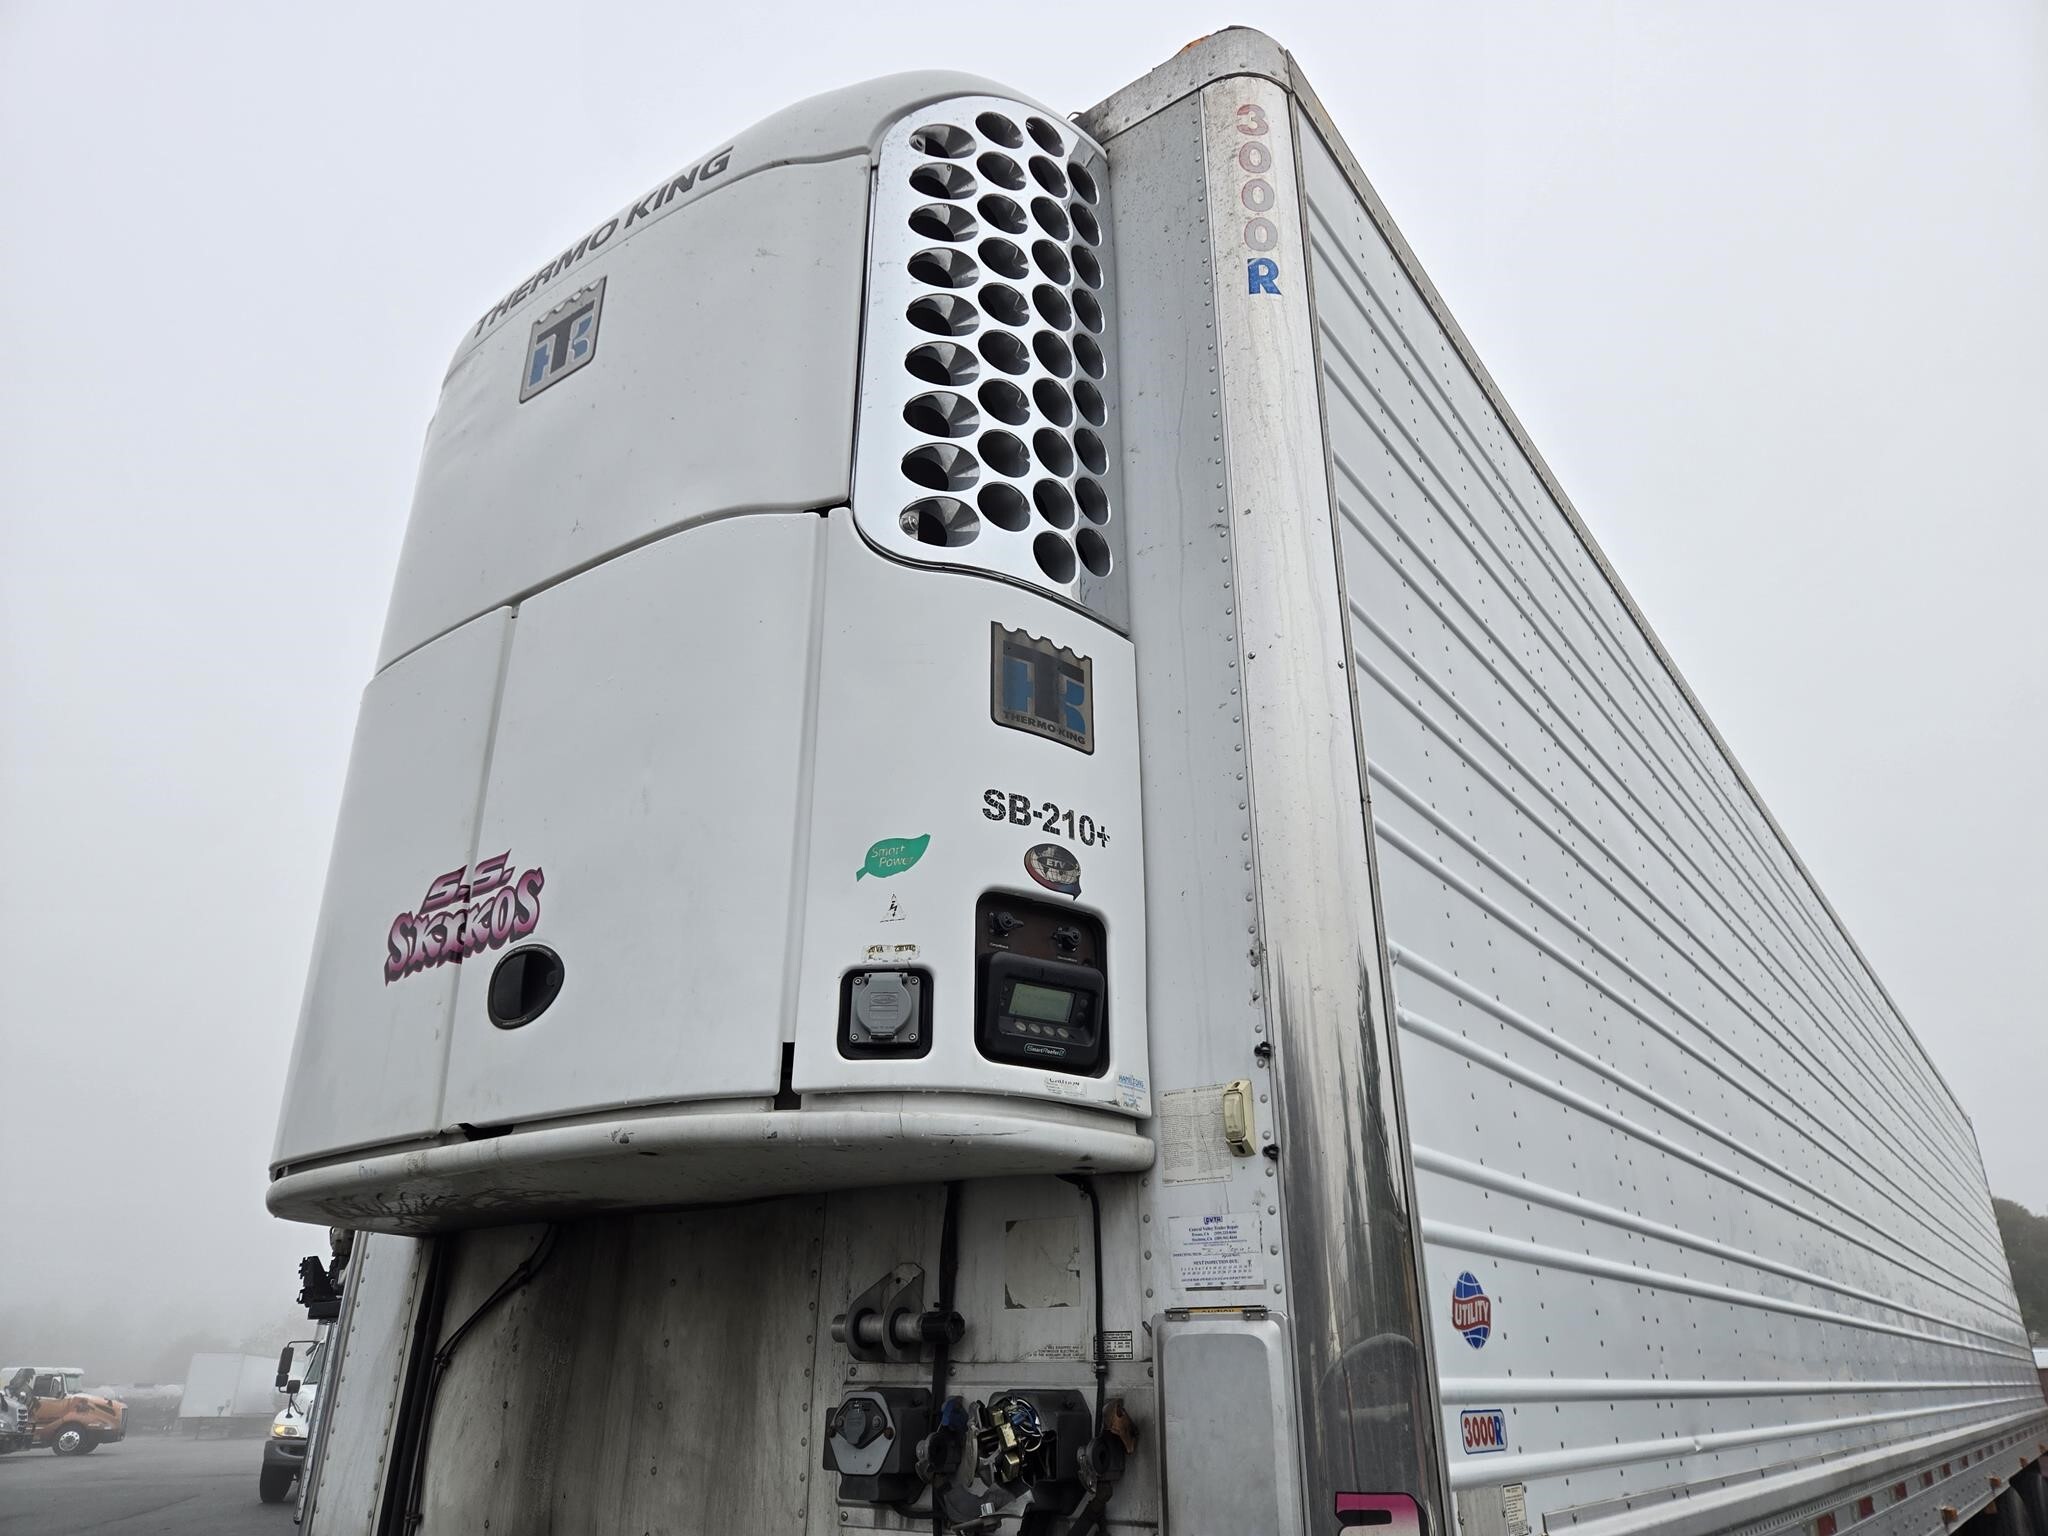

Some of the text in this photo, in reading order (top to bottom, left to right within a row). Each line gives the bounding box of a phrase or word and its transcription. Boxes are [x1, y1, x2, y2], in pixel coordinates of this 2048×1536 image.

[473, 144, 735, 339] THERMO KING
[1003, 711, 1087, 746] THERMO KING
[982, 788, 1111, 848] SB-210+
[871, 845, 906, 858] Smart
[879, 855, 914, 868] Power
[1454, 1300, 1489, 1326] UTILITY
[1464, 1415, 1504, 1448] 3000R
